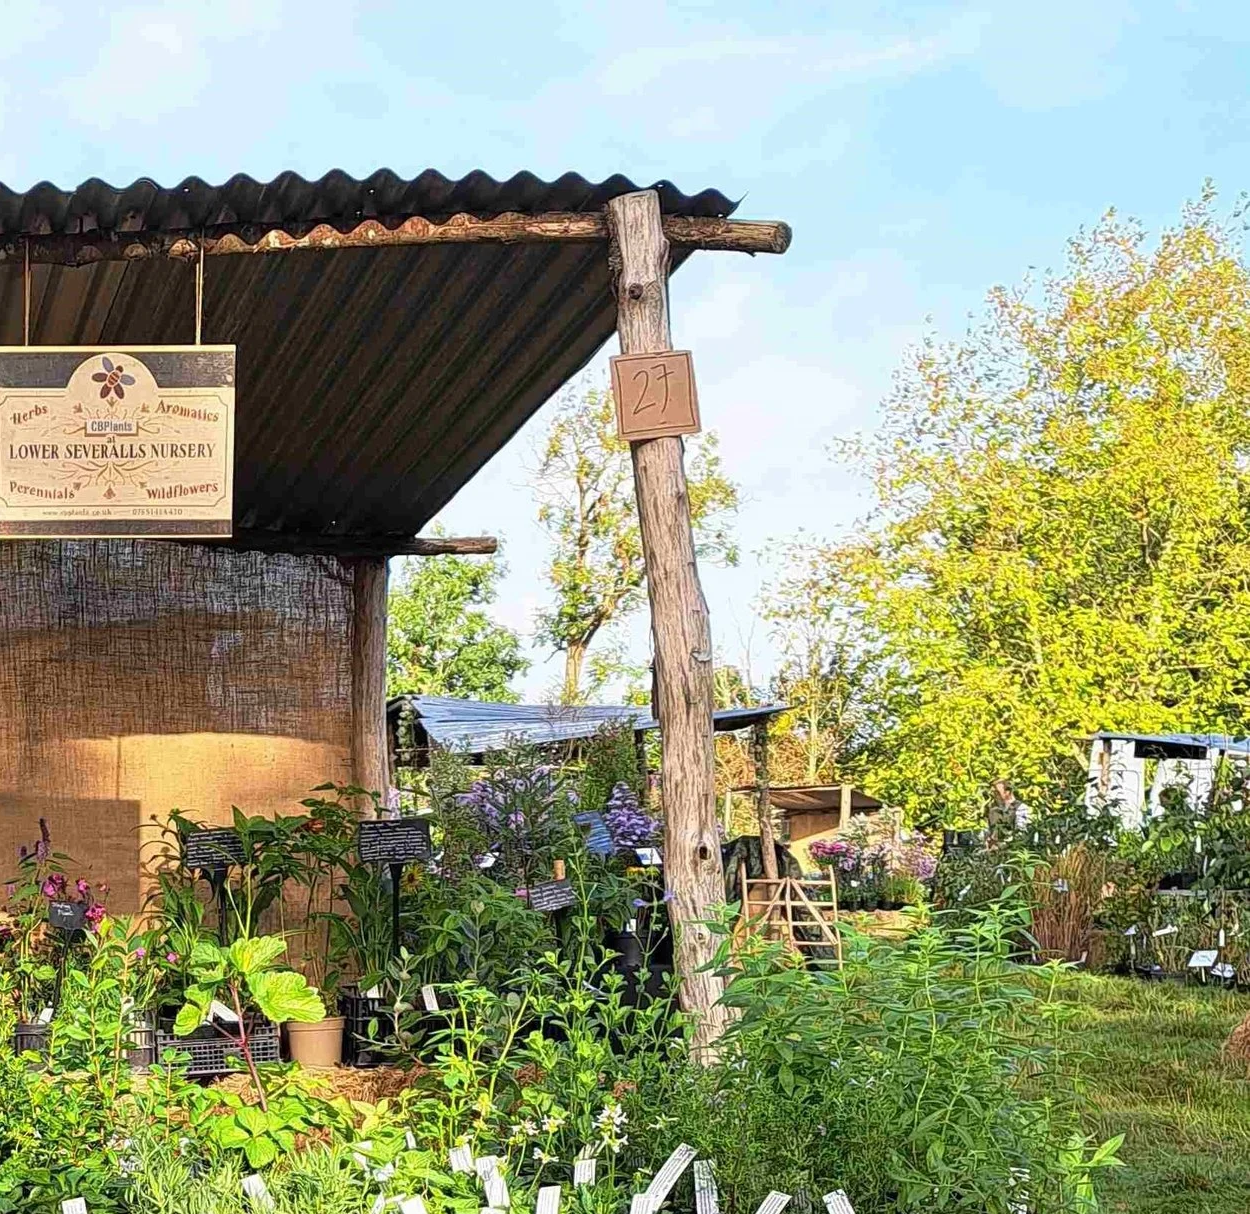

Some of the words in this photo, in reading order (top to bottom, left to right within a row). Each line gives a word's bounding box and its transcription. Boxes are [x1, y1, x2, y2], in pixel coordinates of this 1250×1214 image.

[632, 363, 675, 416] 27
[10, 404, 48, 424] Herbs
[155, 399, 219, 422] Aromatics
[91, 421, 132, 432] CBPlants
[10, 444, 59, 459] LOWER
[65, 443, 146, 459] SEVERALLS
[151, 443, 216, 458] NURSERY
[10, 481, 75, 499] Perennials
[146, 482, 219, 499] Wildflowers
